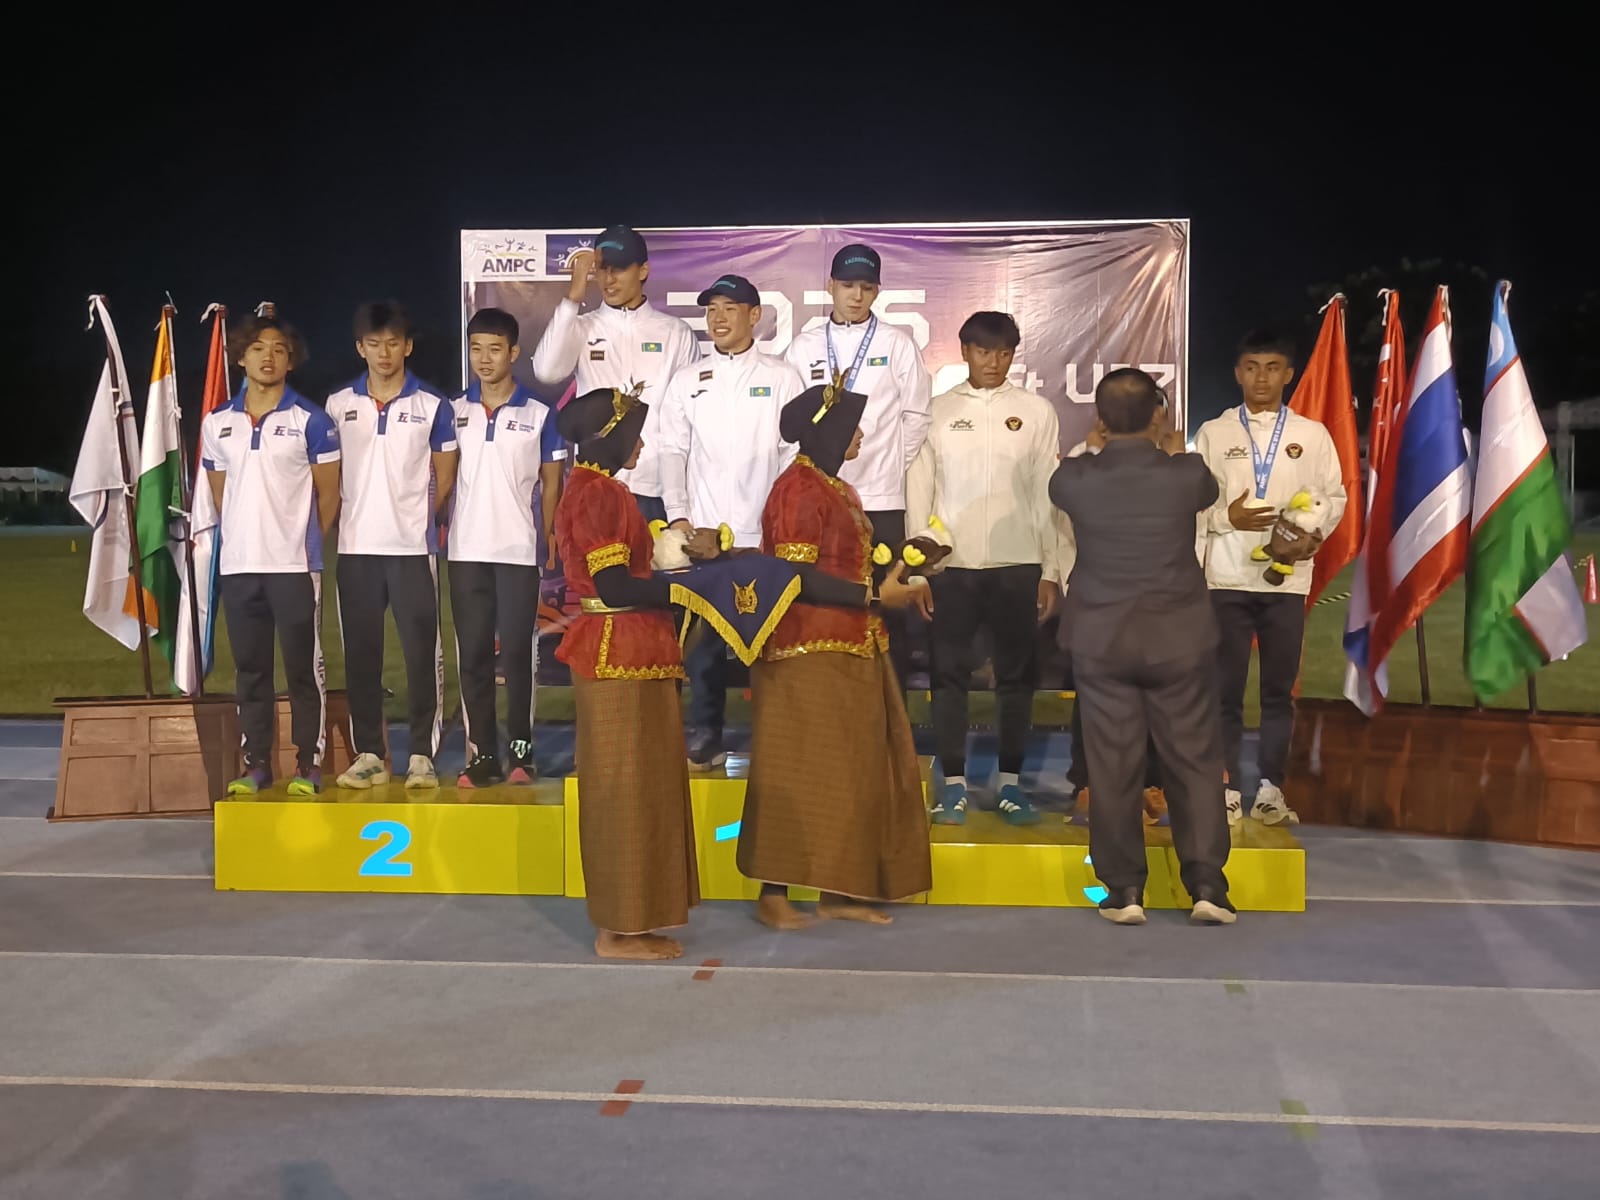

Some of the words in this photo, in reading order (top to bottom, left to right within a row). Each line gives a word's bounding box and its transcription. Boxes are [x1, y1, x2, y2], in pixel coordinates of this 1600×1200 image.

[482, 258, 536, 273] AMPC
[1065, 363, 1176, 404] U7
[359, 819, 412, 876] 2
